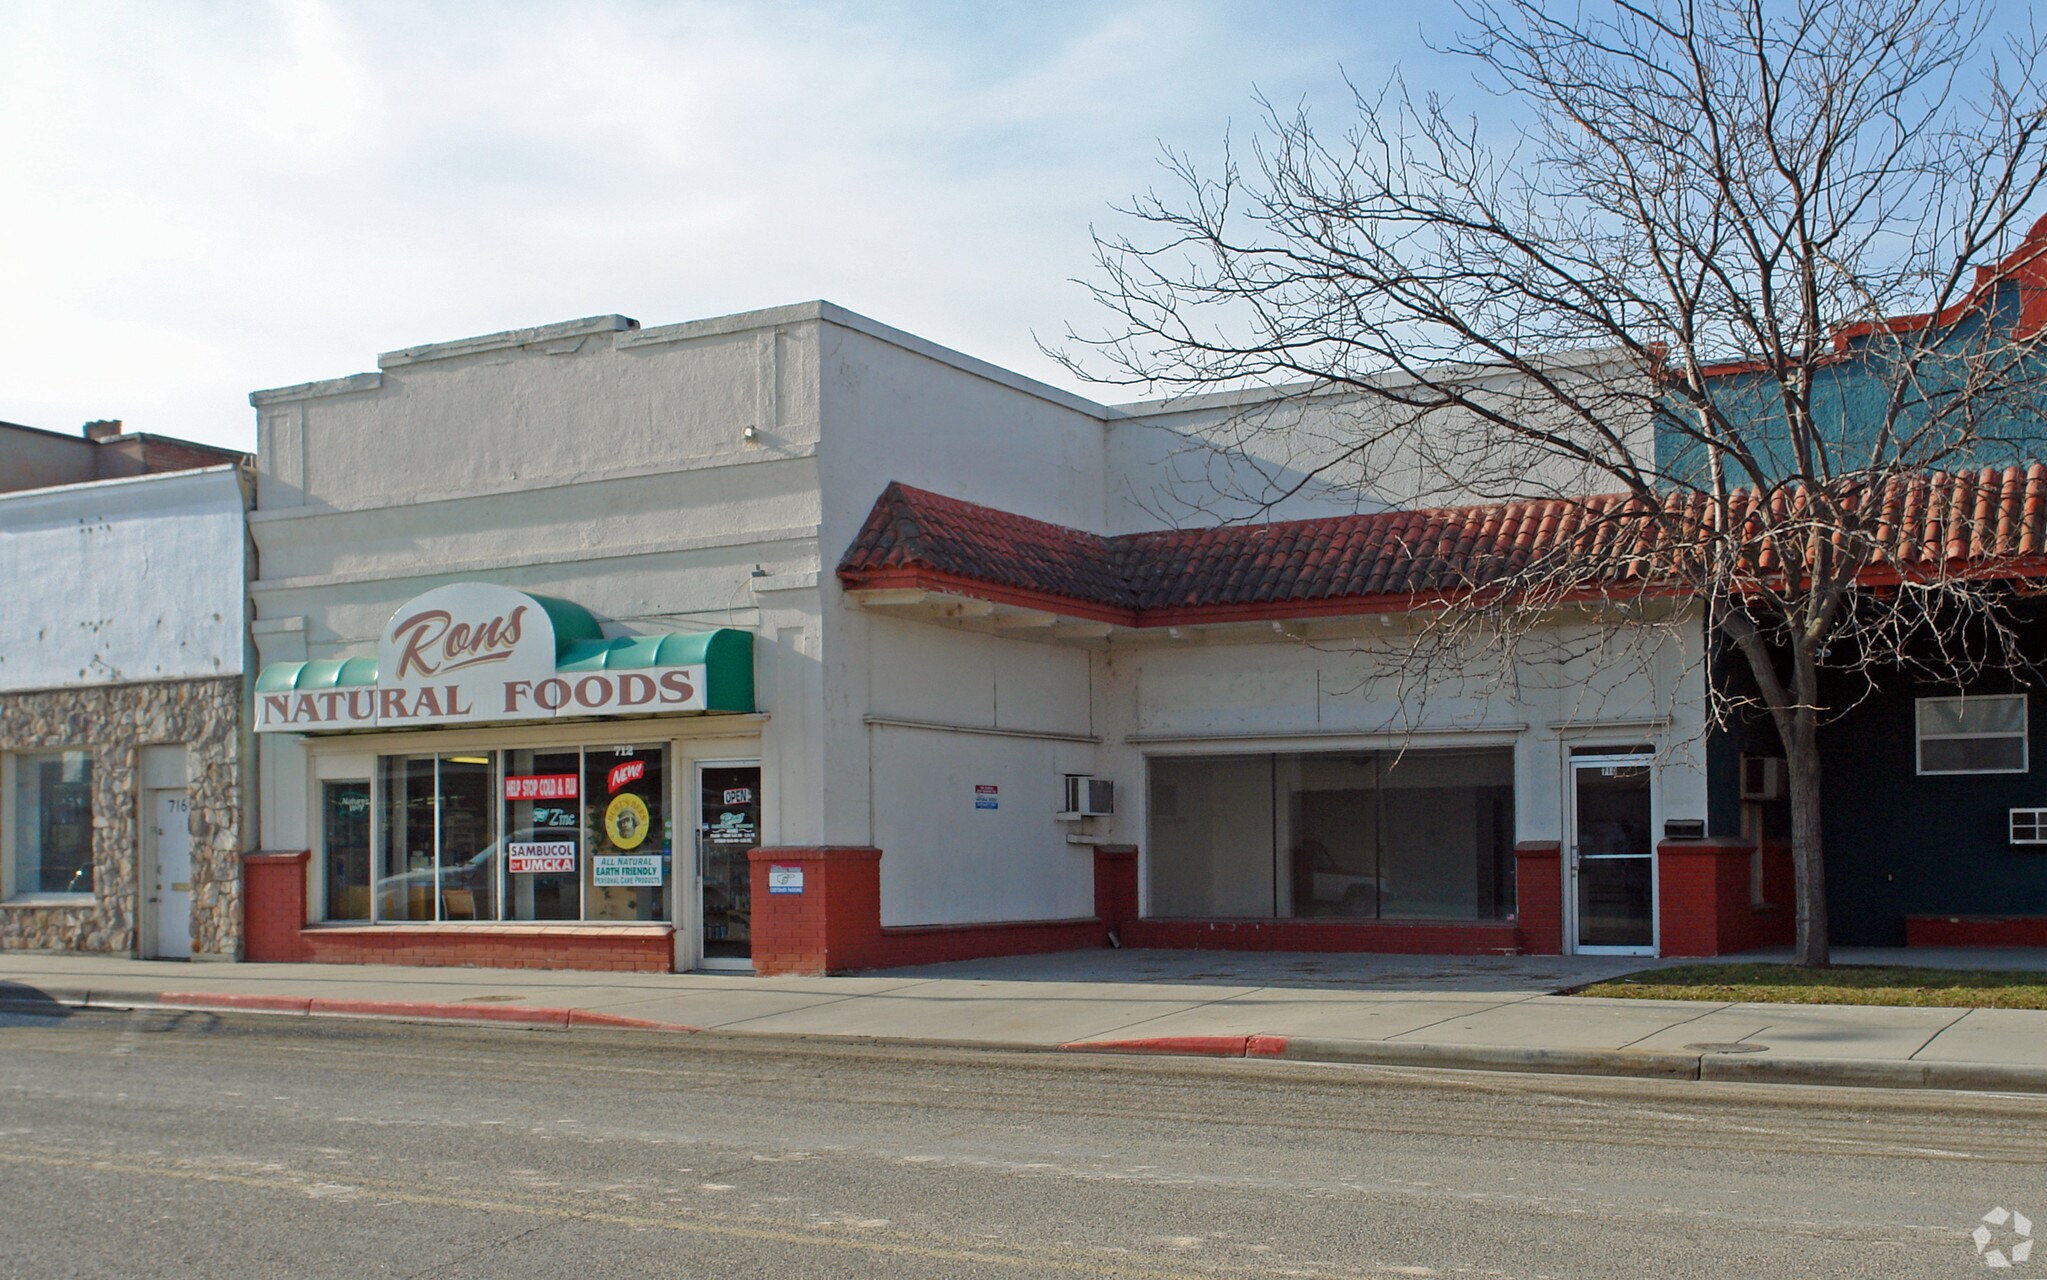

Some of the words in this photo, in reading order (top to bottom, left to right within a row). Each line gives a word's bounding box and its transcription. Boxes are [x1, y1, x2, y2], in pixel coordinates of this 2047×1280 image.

[391, 605, 528, 680] Rons
[262, 684, 472, 724] NATURAL
[503, 670, 695, 713] FOODS
[614, 745, 634, 756] 712
[612, 763, 642, 787] NEW!
[506, 780, 521, 797] HELP
[522, 779, 538, 797] STOP
[540, 778, 556, 796] COLD
[557, 778, 563, 796] &
[565, 777, 576, 795] FLU
[726, 790, 747, 803] OPEN
[168, 799, 188, 813] 716
[549, 808, 575, 826] Zinc
[511, 845, 572, 857] SAMBUCOL
[511, 862, 521, 871] or
[522, 859, 572, 871] UMCKA
[601, 857, 615, 866] ALL
[617, 857, 653, 866] NATURAL
[596, 867, 620, 876] EARTH
[621, 866, 657, 876] FRIENDLY
